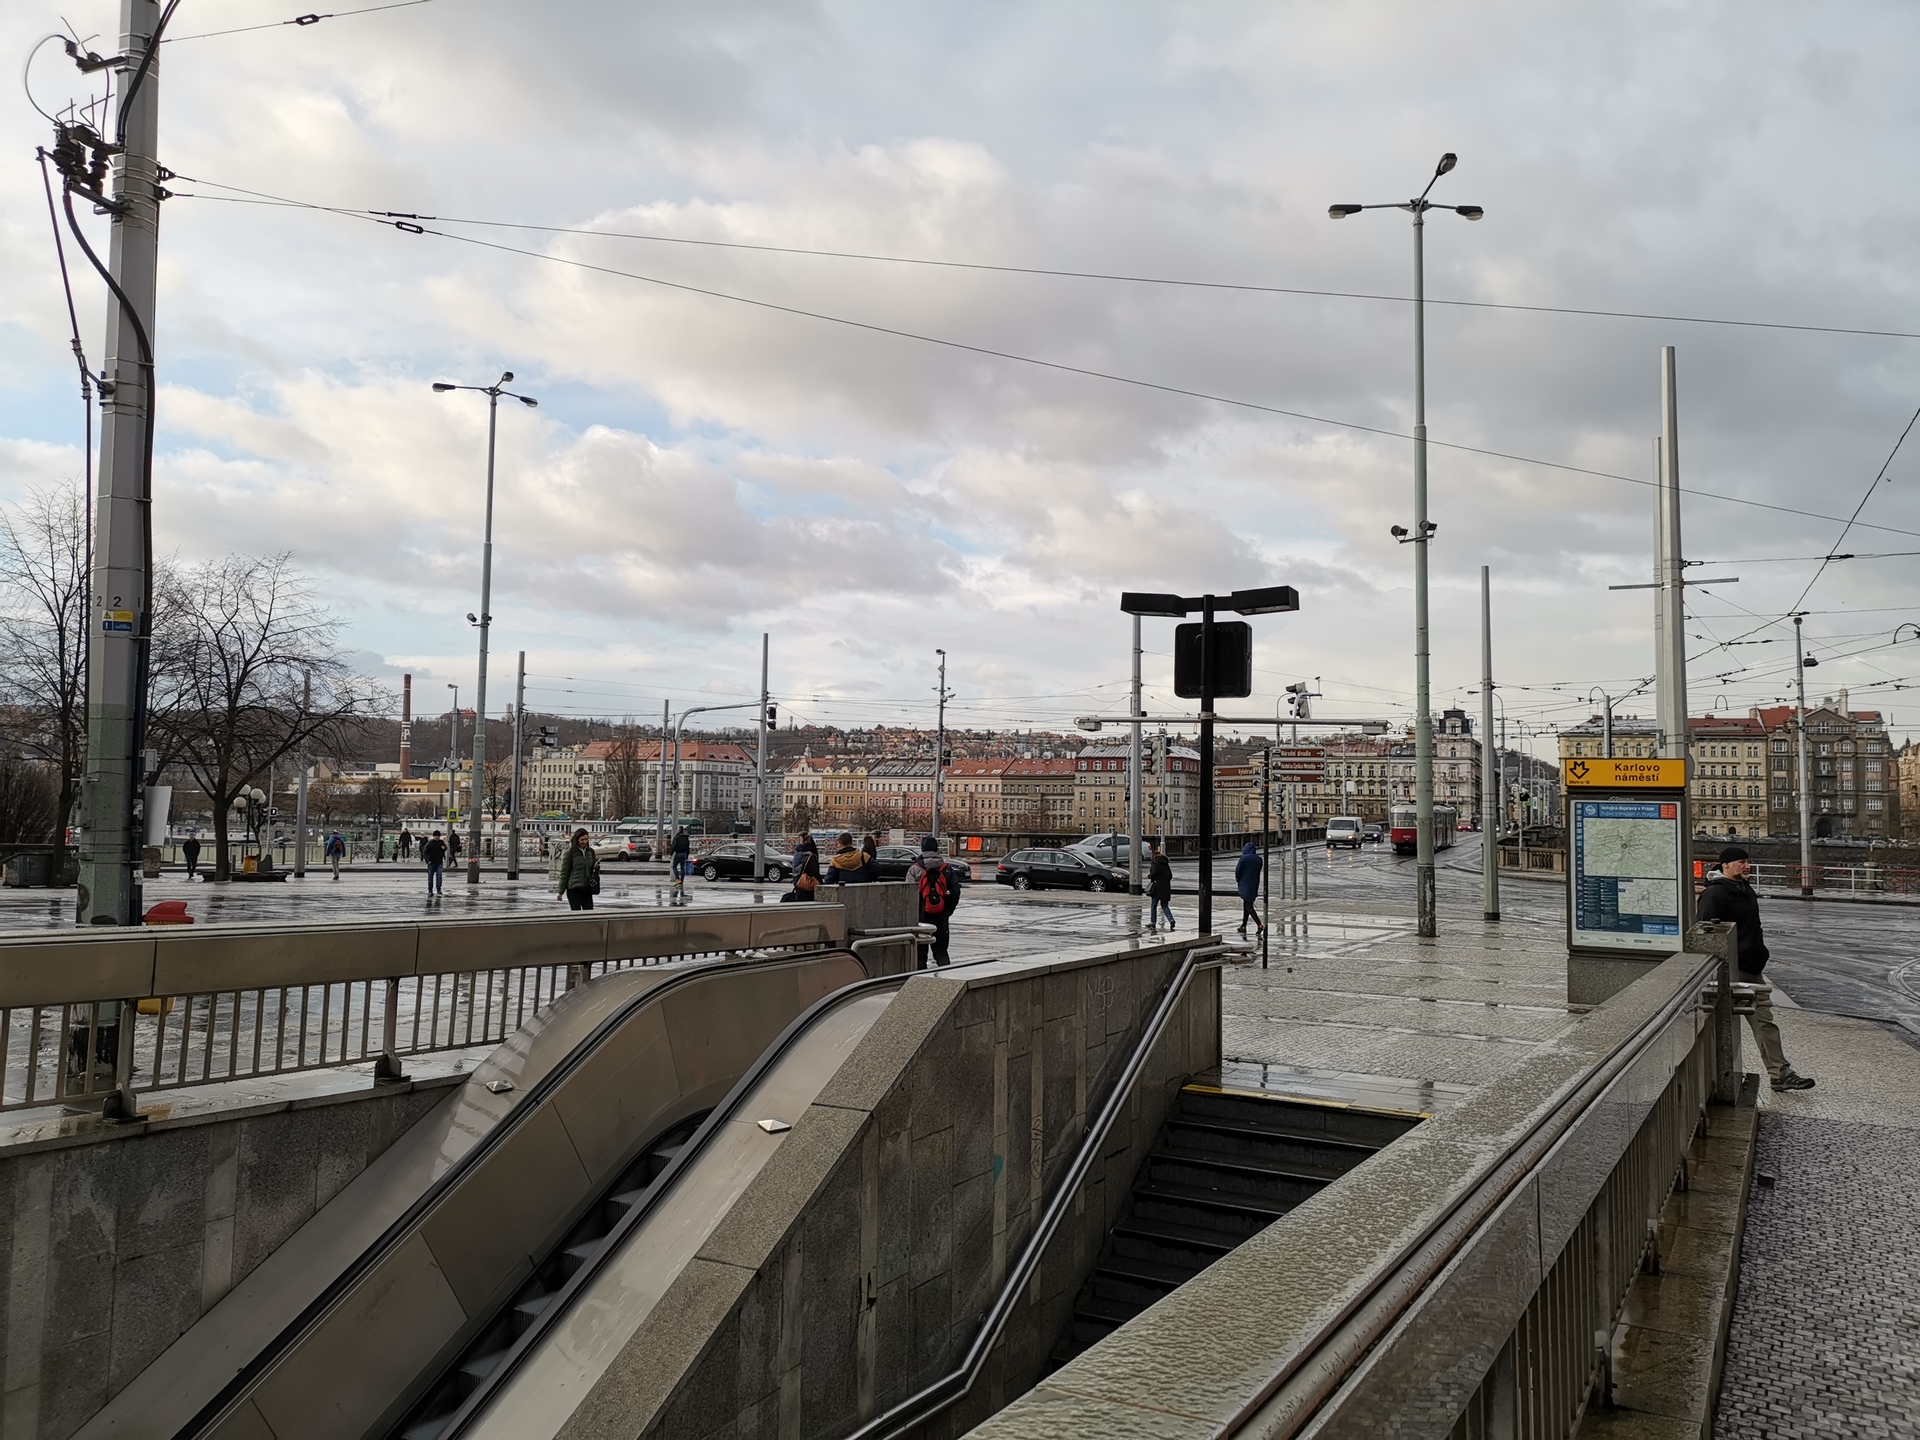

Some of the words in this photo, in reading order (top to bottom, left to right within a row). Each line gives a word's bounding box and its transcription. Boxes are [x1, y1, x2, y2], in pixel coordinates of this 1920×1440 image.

[113, 595, 122, 608] 2
[1614, 763, 1660, 772] Karlovo
[1614, 773, 1660, 782] náměstí
